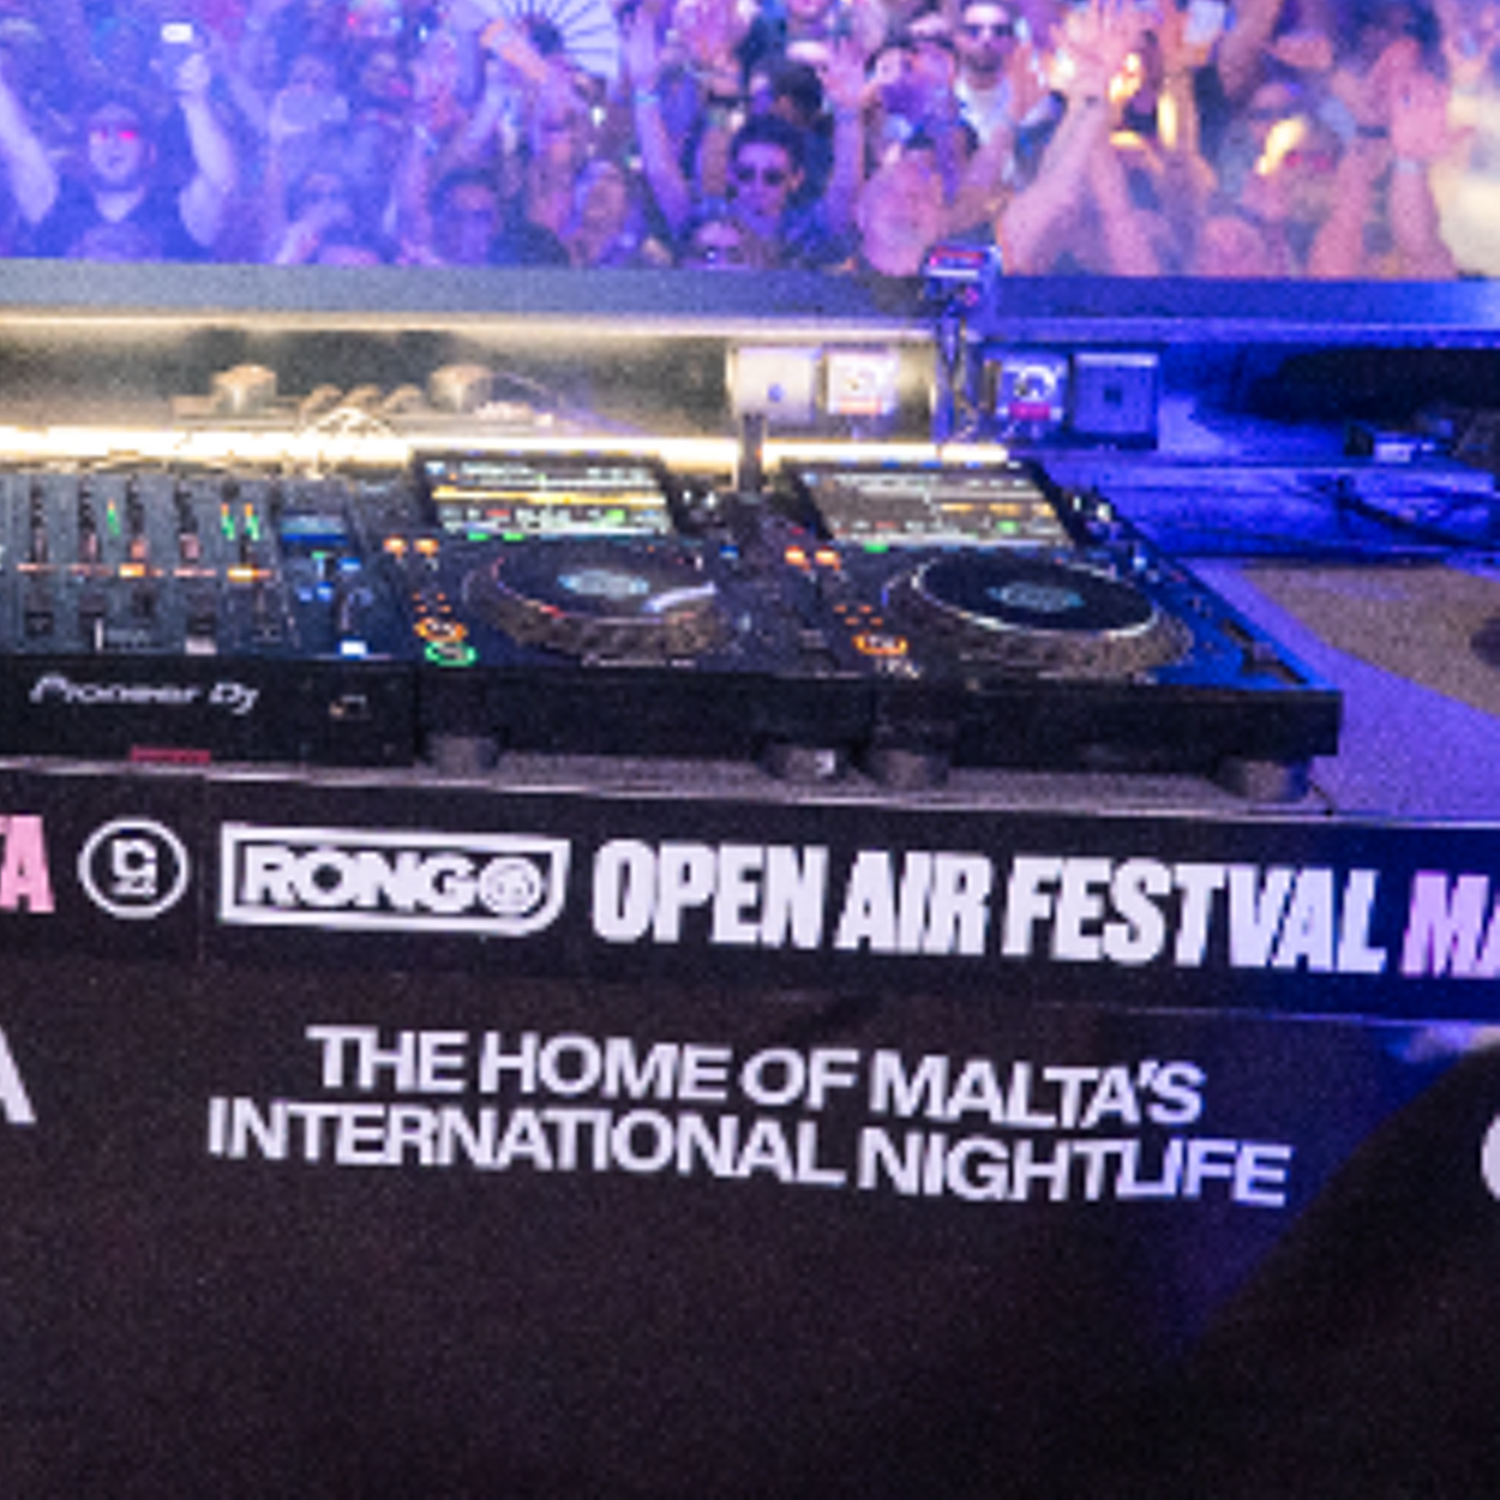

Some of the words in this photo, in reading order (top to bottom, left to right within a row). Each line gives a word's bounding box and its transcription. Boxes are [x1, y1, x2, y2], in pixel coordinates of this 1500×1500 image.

[593, 841, 827, 948] OPEN
[837, 851, 992, 955] AIR
[1002, 856, 1387, 972] FESTVAL
[306, 1026, 466, 1091] THE
[479, 1032, 732, 1099] HOME
[740, 1048, 858, 1109] OF
[868, 1051, 1205, 1129] MALTA'S
[208, 1098, 846, 1185] INTERNATIONAL
[858, 1126, 1293, 1208] NIGHTLIFE
